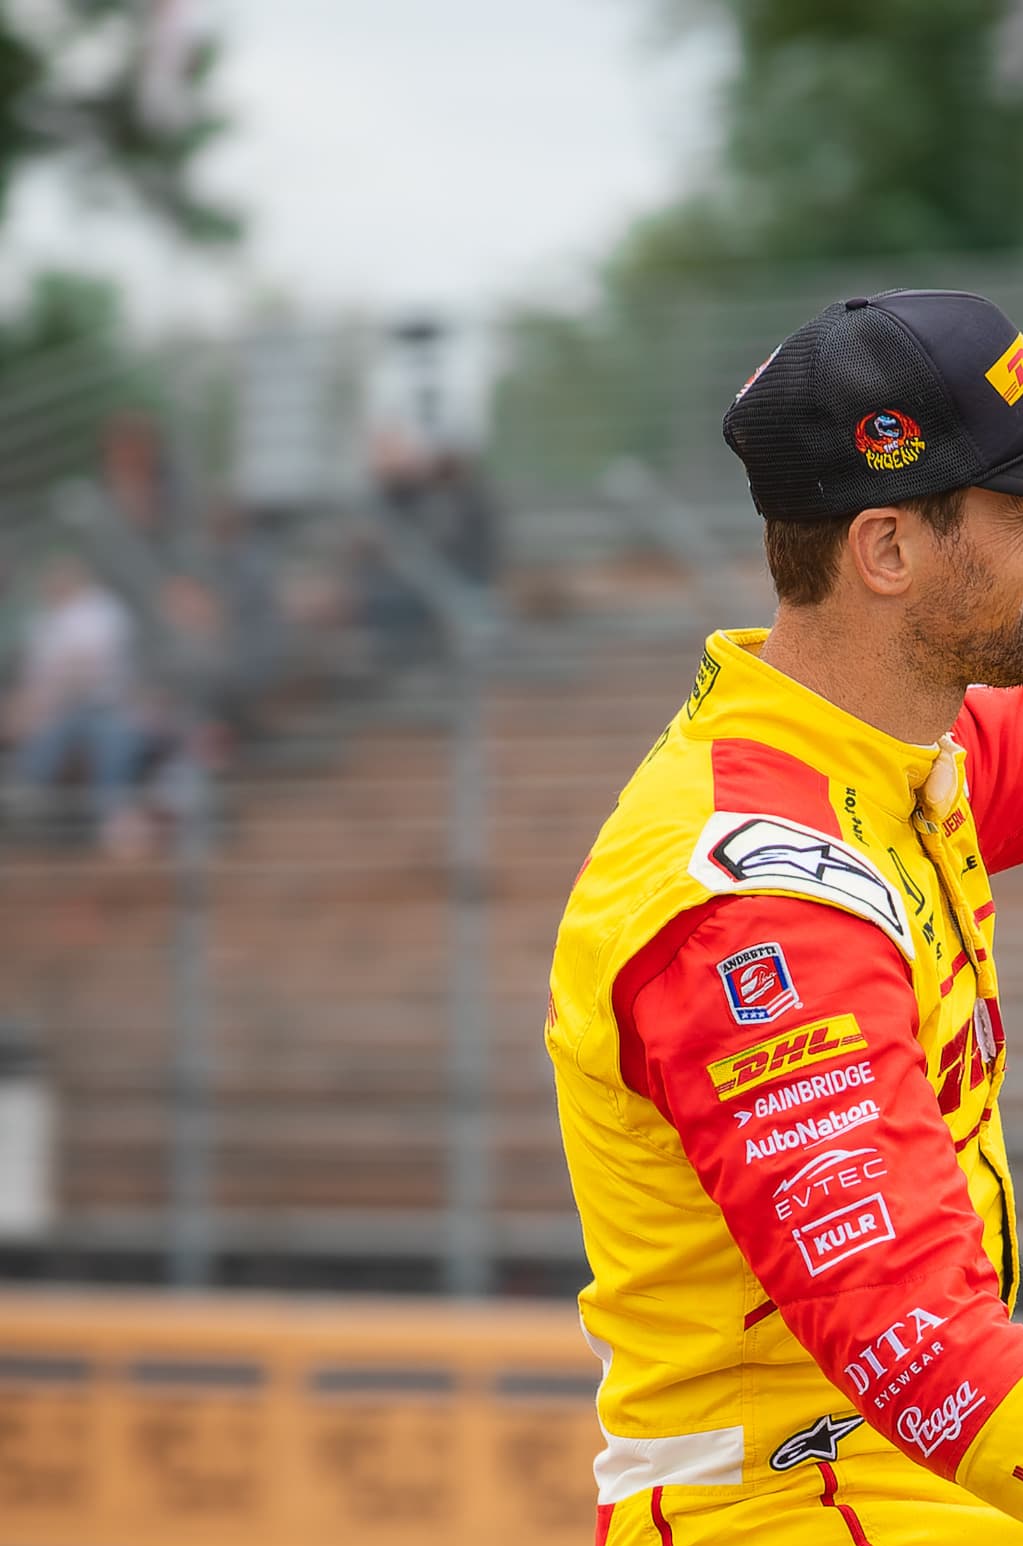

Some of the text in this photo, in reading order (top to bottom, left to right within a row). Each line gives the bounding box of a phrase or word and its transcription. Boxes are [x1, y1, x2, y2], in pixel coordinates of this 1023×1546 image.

[723, 946, 777, 973] ANDRETTI
[732, 1026, 841, 1087] DHL
[755, 1061, 875, 1119] GAINBRIDGE
[745, 1099, 881, 1165] AutoNation
[775, 1158, 888, 1221] EVTEC
[813, 1213, 878, 1256] KULR
[844, 1307, 950, 1396] DITA
[873, 1341, 944, 1409] EYEWEAR
[897, 1381, 986, 1458] Praga
